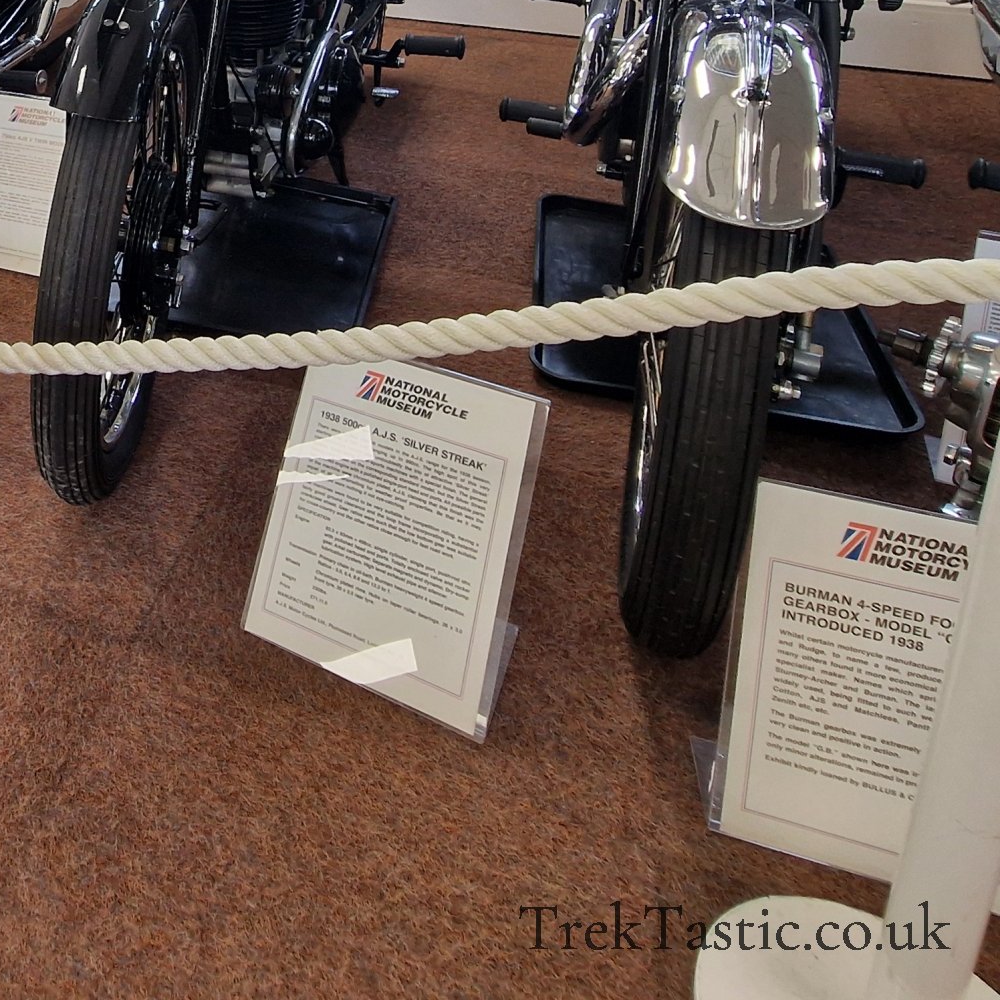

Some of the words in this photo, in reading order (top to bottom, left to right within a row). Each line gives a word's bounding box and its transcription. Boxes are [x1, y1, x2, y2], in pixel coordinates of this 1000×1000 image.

[380, 386, 469, 420] MOTORCYCLE
[385, 375, 449, 403] NATIONAL
[376, 394, 433, 420] MUSEUM
[320, 410, 341, 424] 1938
[342, 416, 367, 430] 500c
[372, 426, 398, 443] A.J.S.
[872, 540, 969, 571] MOTORC
[877, 527, 968, 557] NATIONA
[868, 553, 960, 582] MUSEUM
[782, 595, 860, 622] GEARBOX
[874, 616, 932, 640] MODEL
[784, 581, 853, 607] BURMAN
[856, 599, 925, 624] 4-SPEED
[929, 613, 955, 630] FO
[781, 609, 884, 642] INTRODUCED
[890, 634, 924, 652] 1938
